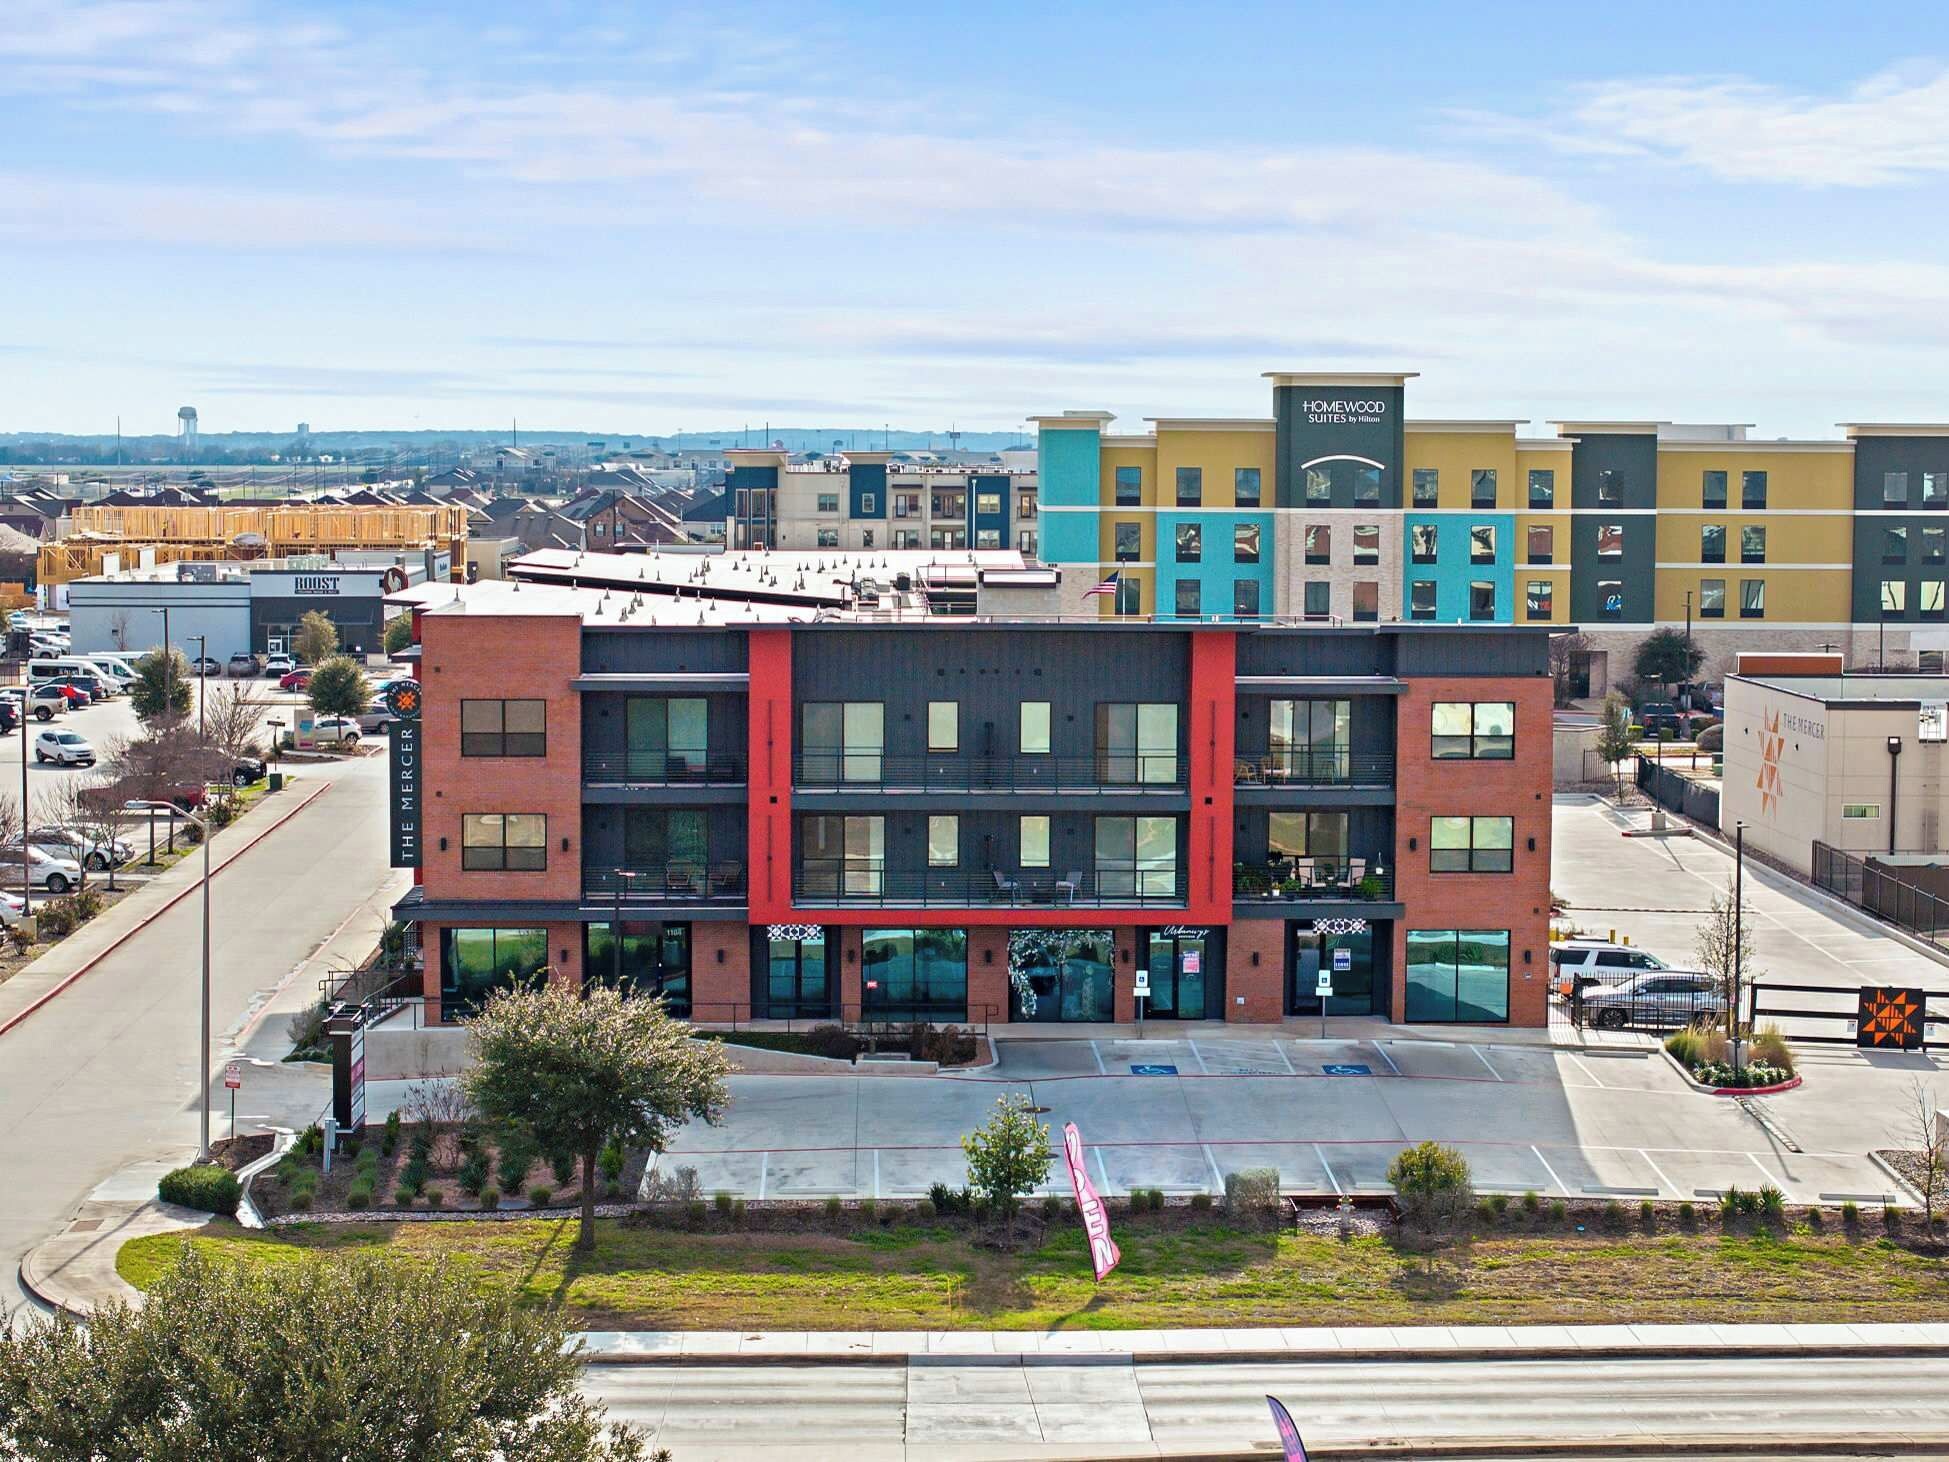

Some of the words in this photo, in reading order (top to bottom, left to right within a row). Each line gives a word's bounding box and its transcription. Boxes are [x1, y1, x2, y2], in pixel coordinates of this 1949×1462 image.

[1303, 400, 1385, 413] HOMEWOOD
[1308, 413, 1347, 423] SUITES
[1348, 415, 1357, 424] by
[1358, 415, 1380, 423] Hilton
[295, 576, 340, 589] ROOST
[1783, 712, 1797, 732] THE
[1797, 717, 1825, 740] MERCER
[401, 728, 413, 810] MERCER
[402, 822, 414, 861] THE
